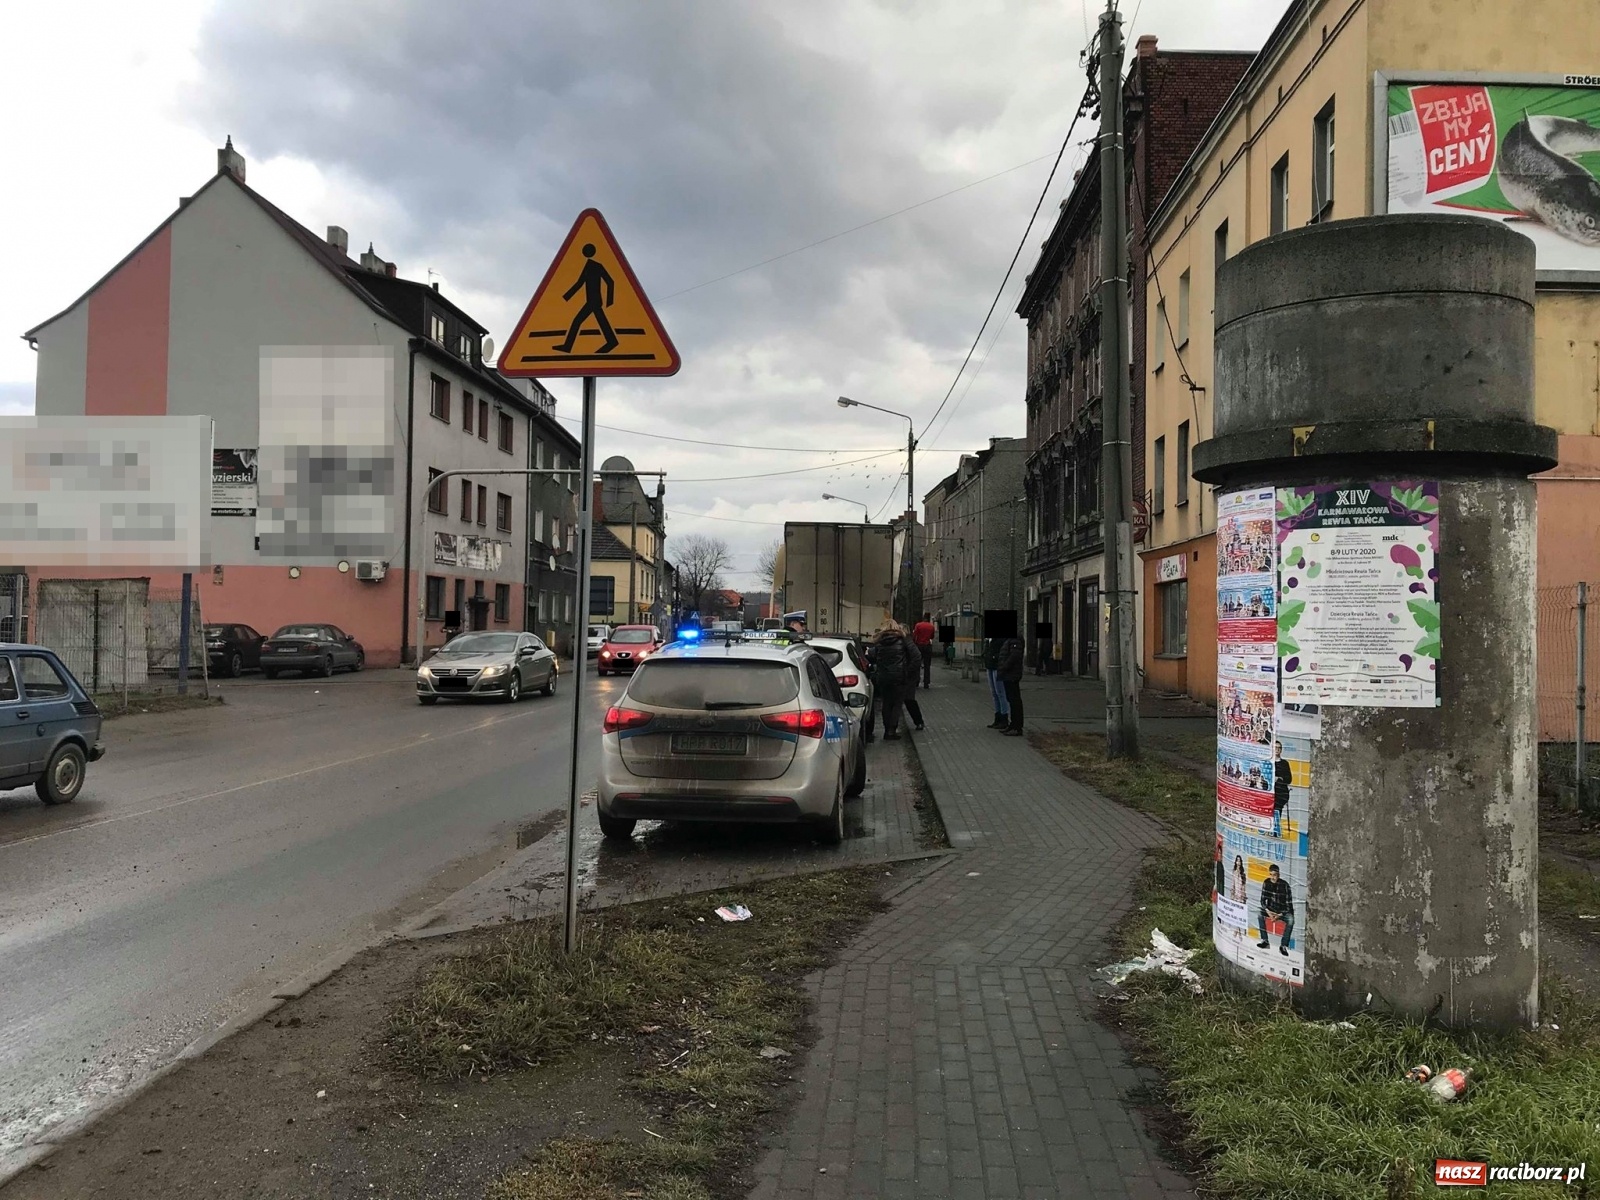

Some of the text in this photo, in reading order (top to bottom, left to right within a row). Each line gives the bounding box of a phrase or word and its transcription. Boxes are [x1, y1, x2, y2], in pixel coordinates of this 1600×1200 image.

[1419, 92, 1488, 125] ZBIJA
[1443, 115, 1472, 142] MY
[1429, 132, 1491, 176] CENY
[1336, 489, 1371, 506] XIV
[1322, 514, 1386, 526] REWIA TAŃCA
[1341, 548, 1358, 556] LUTY
[744, 631, 776, 639] POLICJA
